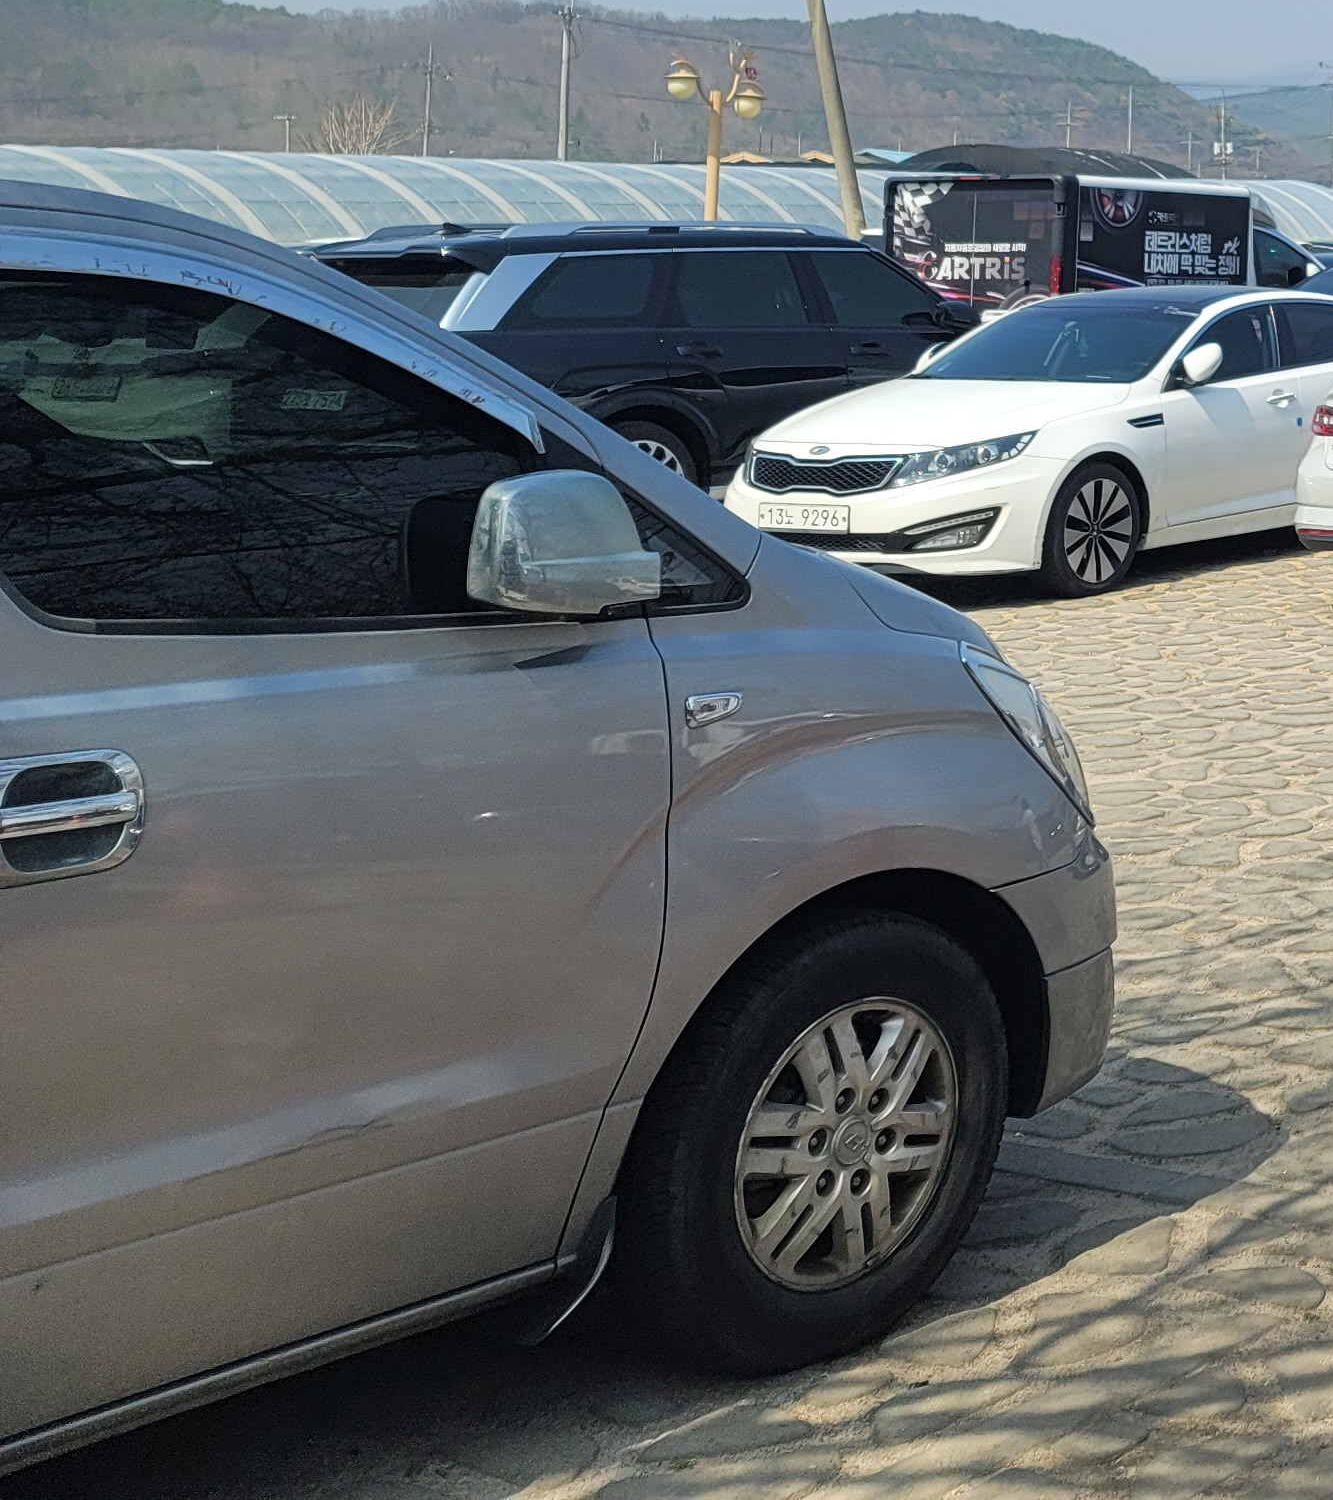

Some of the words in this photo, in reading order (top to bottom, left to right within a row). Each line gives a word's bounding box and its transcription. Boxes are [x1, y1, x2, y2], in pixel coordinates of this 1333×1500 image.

[1143, 252, 1179, 275] 내차에
[1180, 254, 1193, 275] 딱
[1194, 254, 1217, 276] 맞는
[1217, 255, 1241, 276] 정비
[768, 508, 794, 525] 13노
[801, 508, 839, 527] 9296
